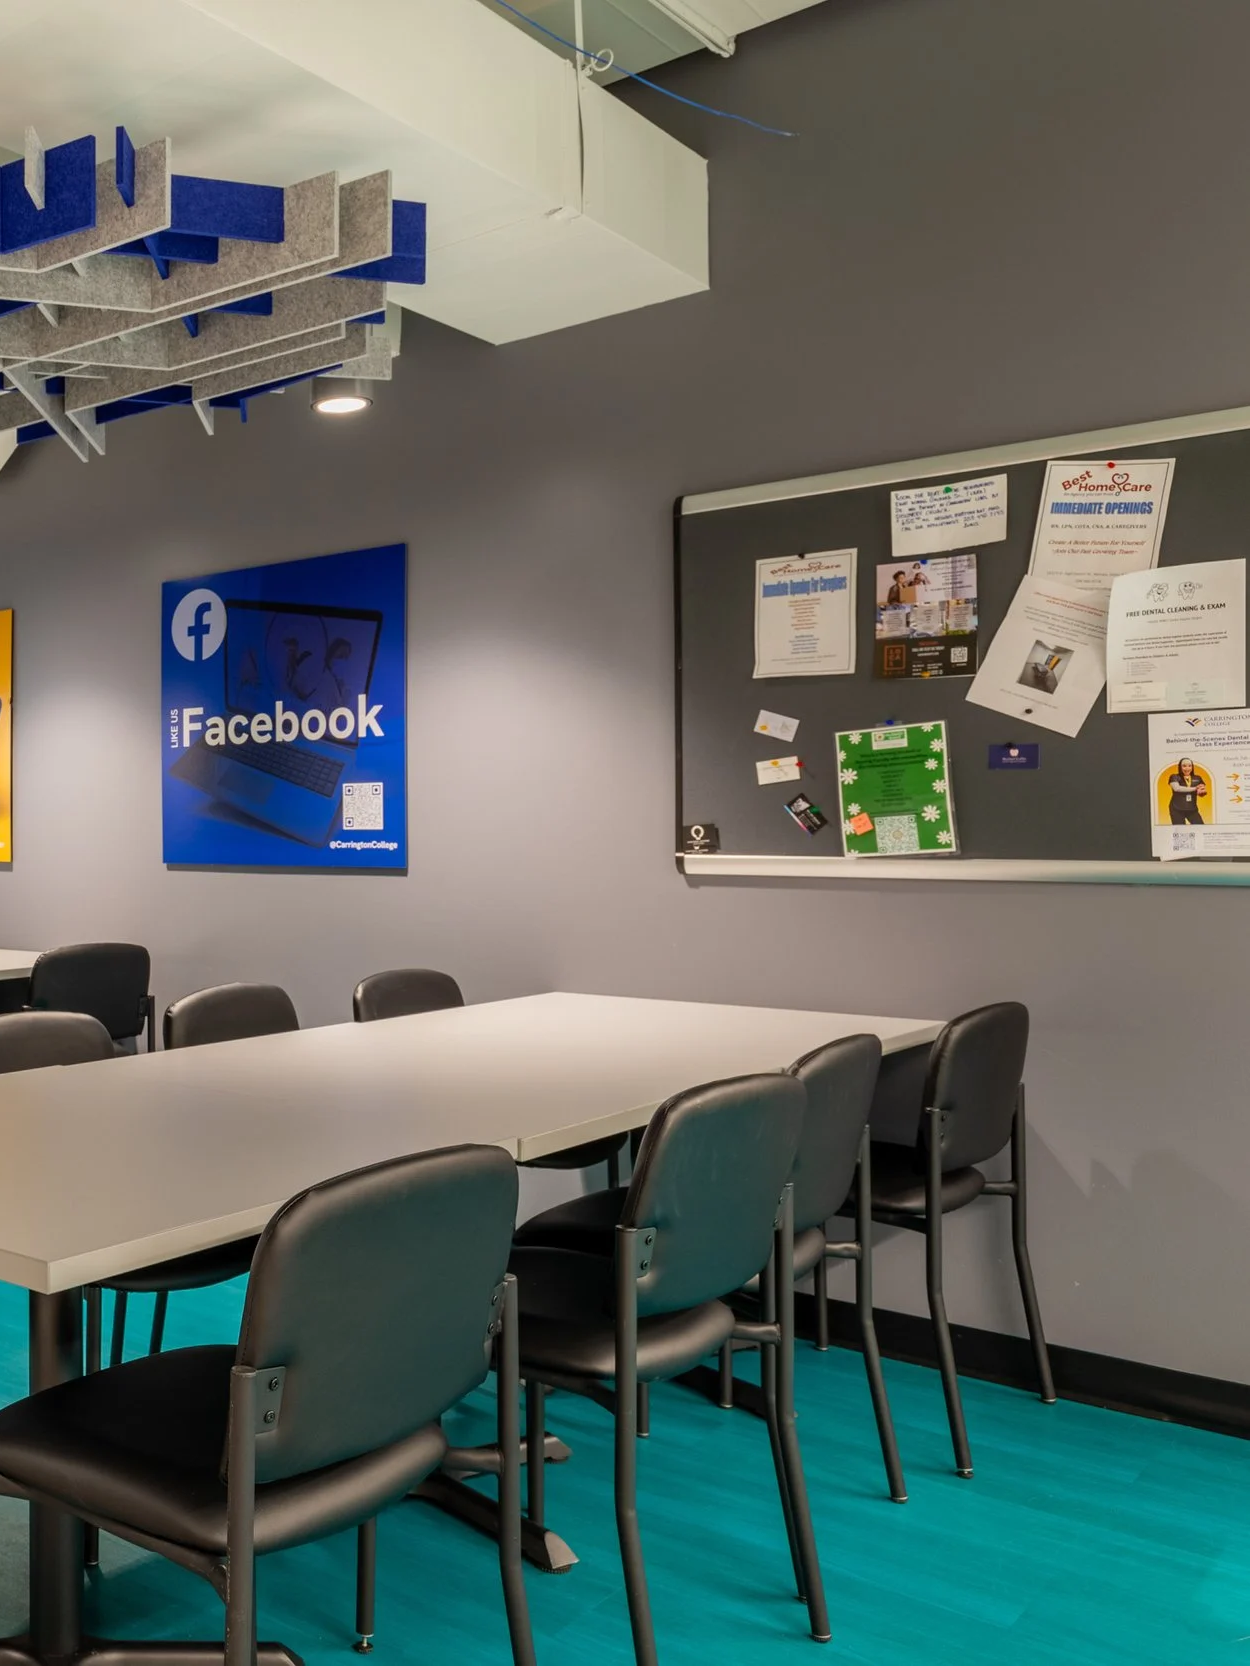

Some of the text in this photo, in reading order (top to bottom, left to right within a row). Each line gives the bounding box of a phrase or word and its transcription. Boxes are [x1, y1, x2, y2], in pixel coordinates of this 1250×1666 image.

[1062, 470, 1093, 491] Best
[1050, 501, 1154, 515] IMMEDIATE OPENINGS
[770, 563, 793, 575] Best
[1126, 610, 1140, 618] FREE
[1142, 608, 1165, 617] DENTAL
[1167, 605, 1199, 614] CLEANING
[1207, 602, 1226, 610] EXAM
[170, 709, 178, 748] LIKE US
[183, 694, 384, 747] Facebook
[330, 841, 398, 850] @CarringtonCollege
